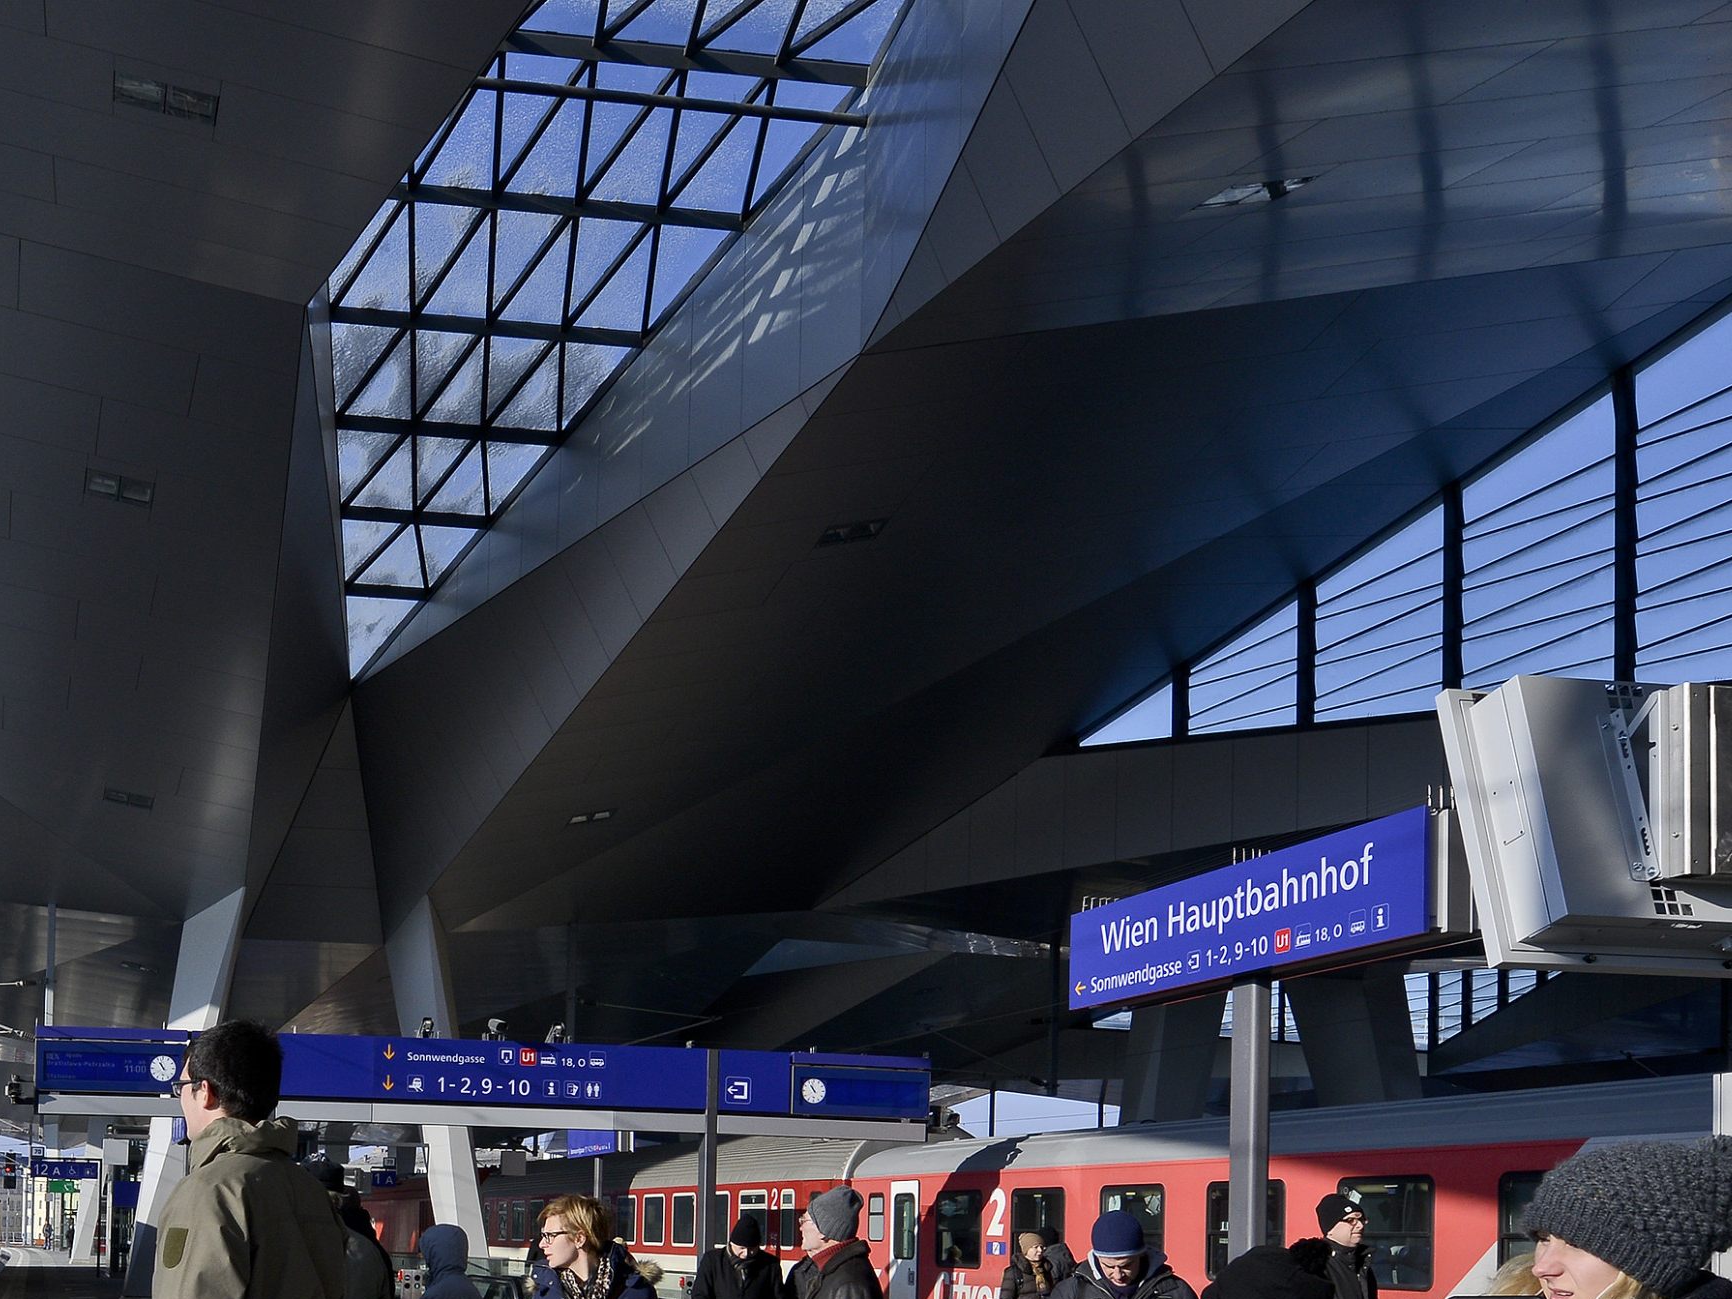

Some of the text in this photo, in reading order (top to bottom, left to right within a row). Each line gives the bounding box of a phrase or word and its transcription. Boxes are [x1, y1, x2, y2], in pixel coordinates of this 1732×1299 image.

[1100, 841, 1375, 955] Wien Hauptbahnhof
[1090, 958, 1183, 994] Sonnwendgasse
[1276, 931, 1290, 949] U1
[406, 1051, 486, 1066] Sonnwendgasse
[521, 1051, 535, 1062] U1
[33, 1164, 61, 1176] 12 A
[373, 1173, 394, 1185] 1 A
[770, 1187, 779, 1211] 2
[986, 1186, 1007, 1237] 2
